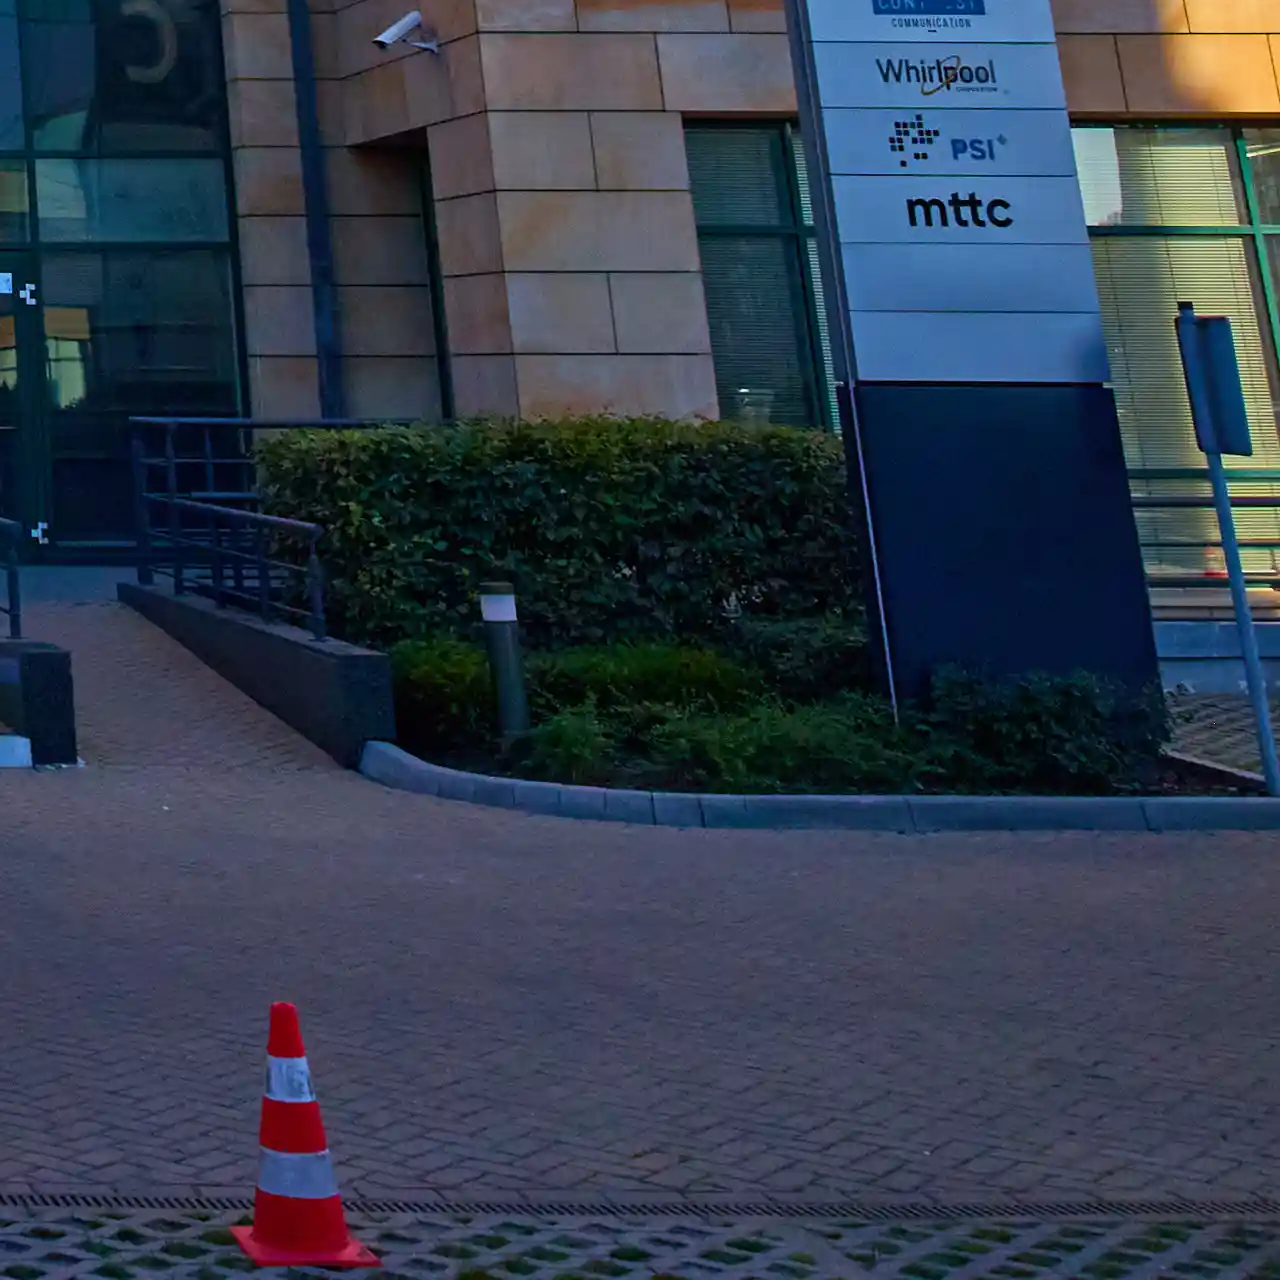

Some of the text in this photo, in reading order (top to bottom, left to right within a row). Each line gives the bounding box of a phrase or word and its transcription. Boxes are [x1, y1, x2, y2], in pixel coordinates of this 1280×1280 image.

[891, 17, 973, 29] COMMUNICATION
[875, 58, 997, 92] Whirlpool
[951, 138, 996, 162] PSI
[906, 192, 1015, 228] mttc
